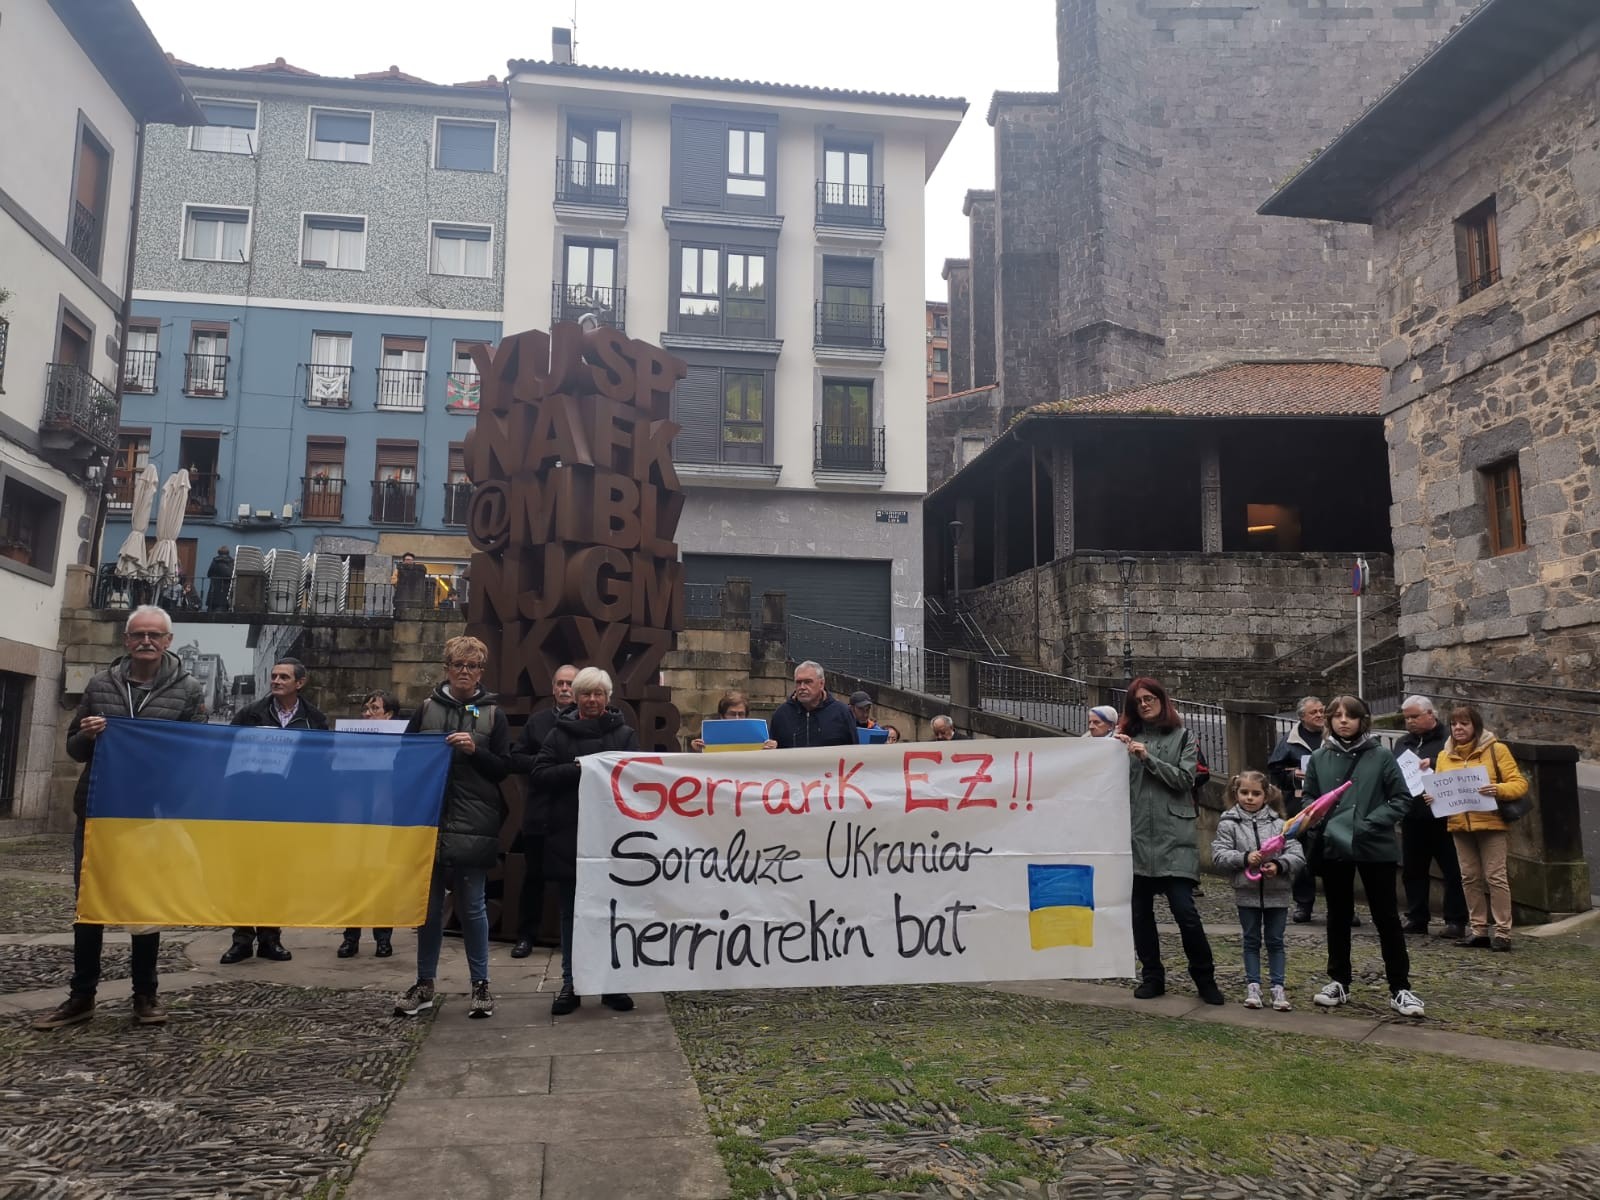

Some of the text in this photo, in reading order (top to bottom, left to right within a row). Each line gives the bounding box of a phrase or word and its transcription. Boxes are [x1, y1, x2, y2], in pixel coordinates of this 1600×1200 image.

[609, 829, 804, 887] Soraluze
[610, 892, 976, 971] herriarekin bat
